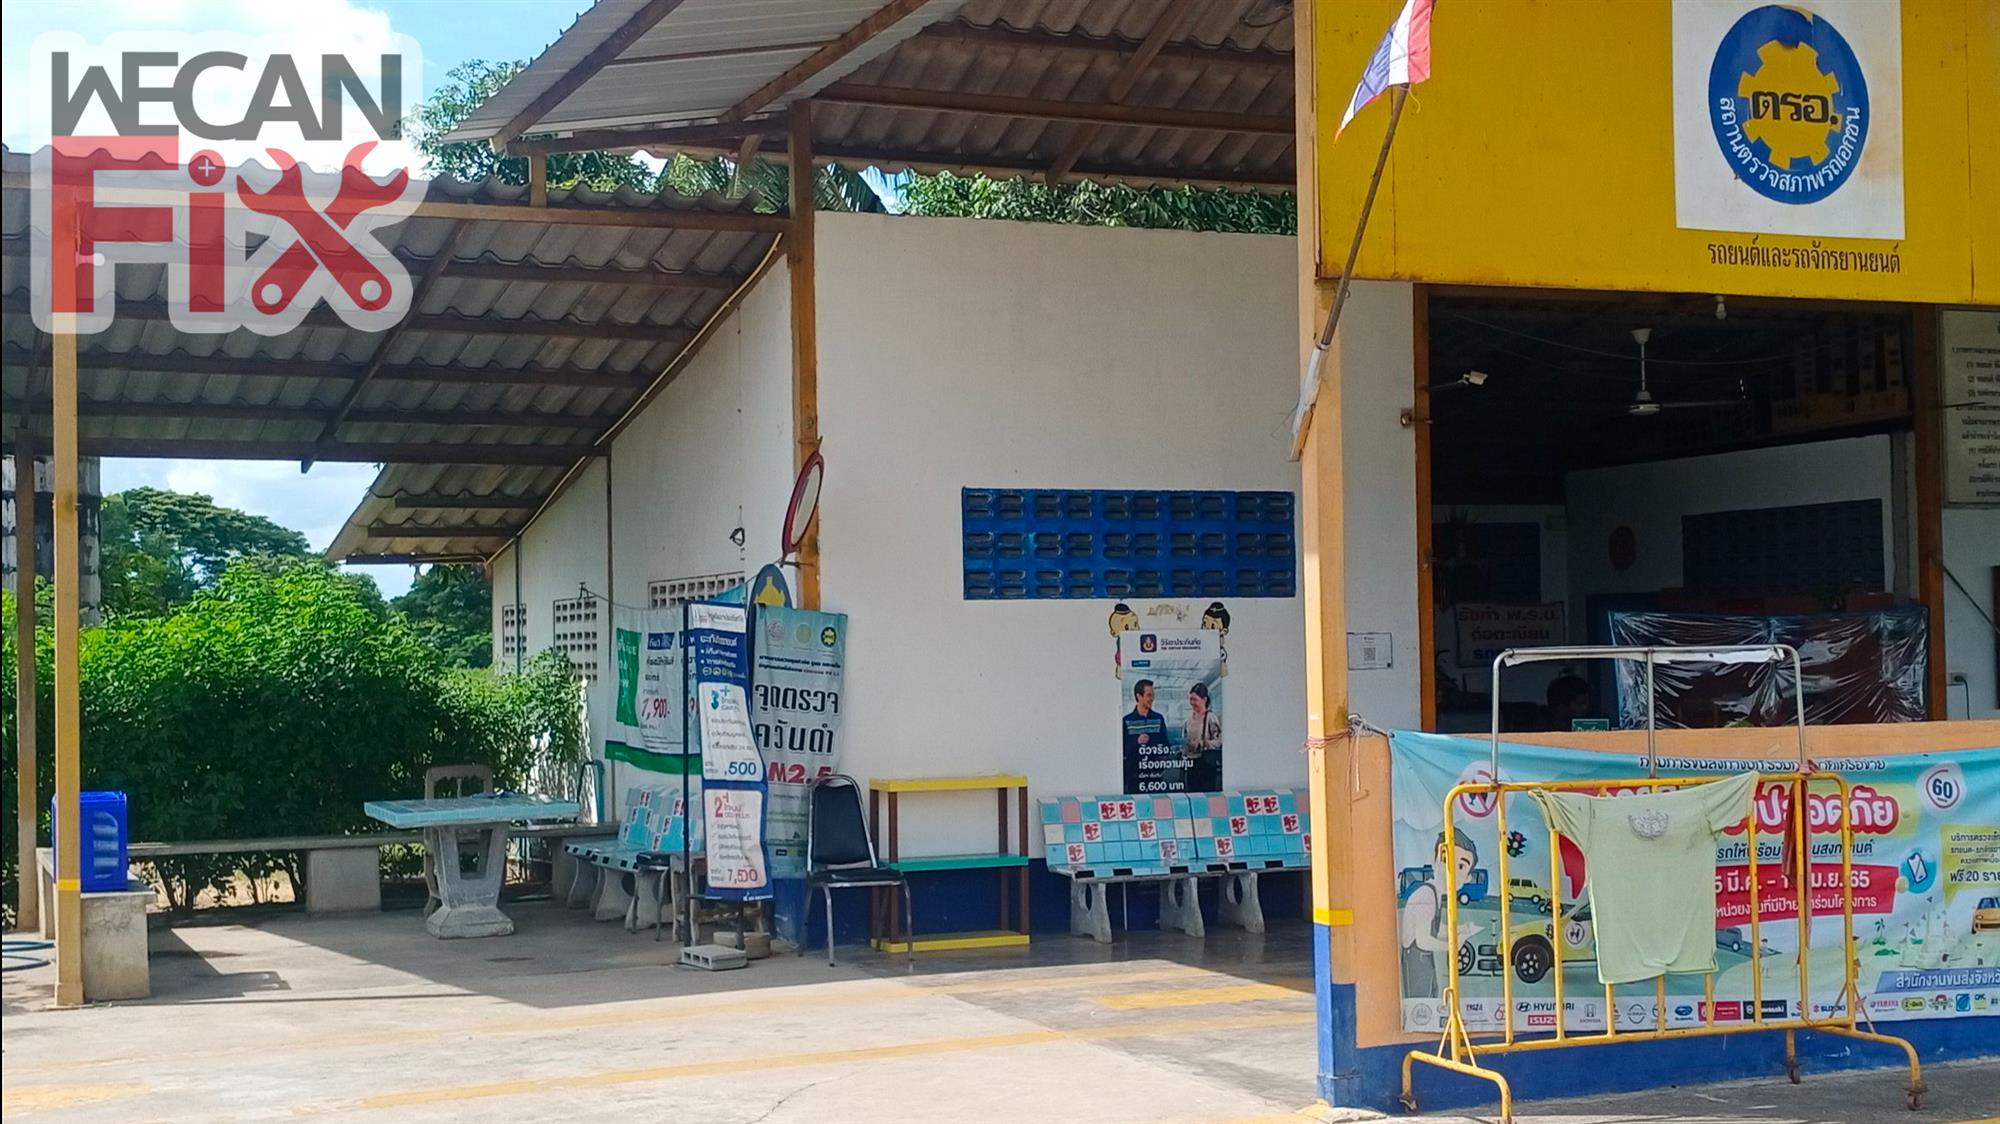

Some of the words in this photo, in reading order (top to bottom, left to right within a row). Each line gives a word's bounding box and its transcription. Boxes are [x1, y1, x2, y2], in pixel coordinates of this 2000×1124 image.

[1751, 91, 1839, 125] ตรอ.
[1719, 97, 1861, 192] สถานตรวจสภาพรถเอกชน
[1708, 235, 1901, 273] รถยนต์และรถจักรยานยนต์
[755, 684, 839, 714] จุดตรวจ
[755, 719, 834, 753] ควันดำ
[1138, 755, 1194, 771] เรื่องความคุ้ม
[1138, 781, 1167, 792] 6,600
[1168, 781, 1185, 791] บาท
[1932, 778, 1953, 799] 60
[1811, 871, 1843, 888] ม.ย.
[1850, 870, 1870, 888] 65
[1966, 870, 1979, 882] 20
[1533, 1002, 1575, 1011] HYUAI
